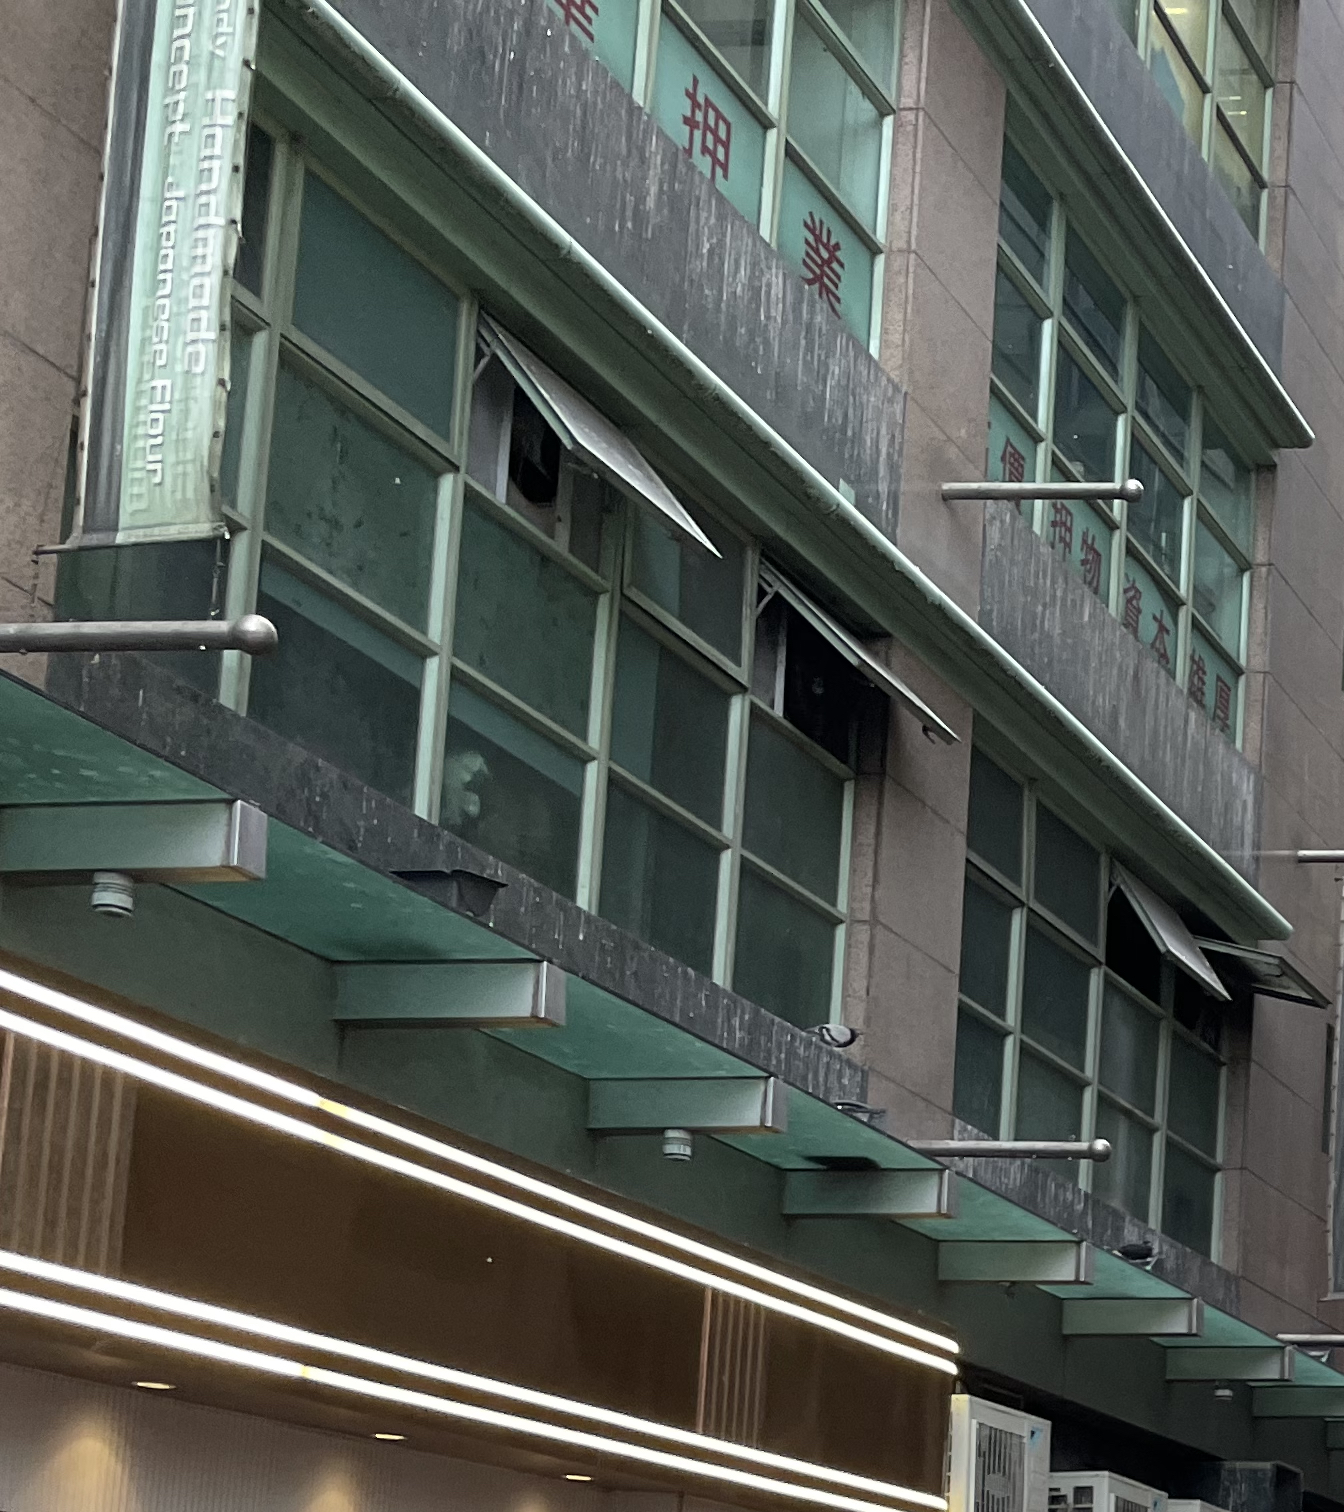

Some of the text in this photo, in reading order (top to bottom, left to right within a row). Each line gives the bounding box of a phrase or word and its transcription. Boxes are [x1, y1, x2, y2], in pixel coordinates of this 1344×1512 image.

[145, 0, 196, 487] ncept Japanese Flour
[184, 89, 237, 374] Handmade
